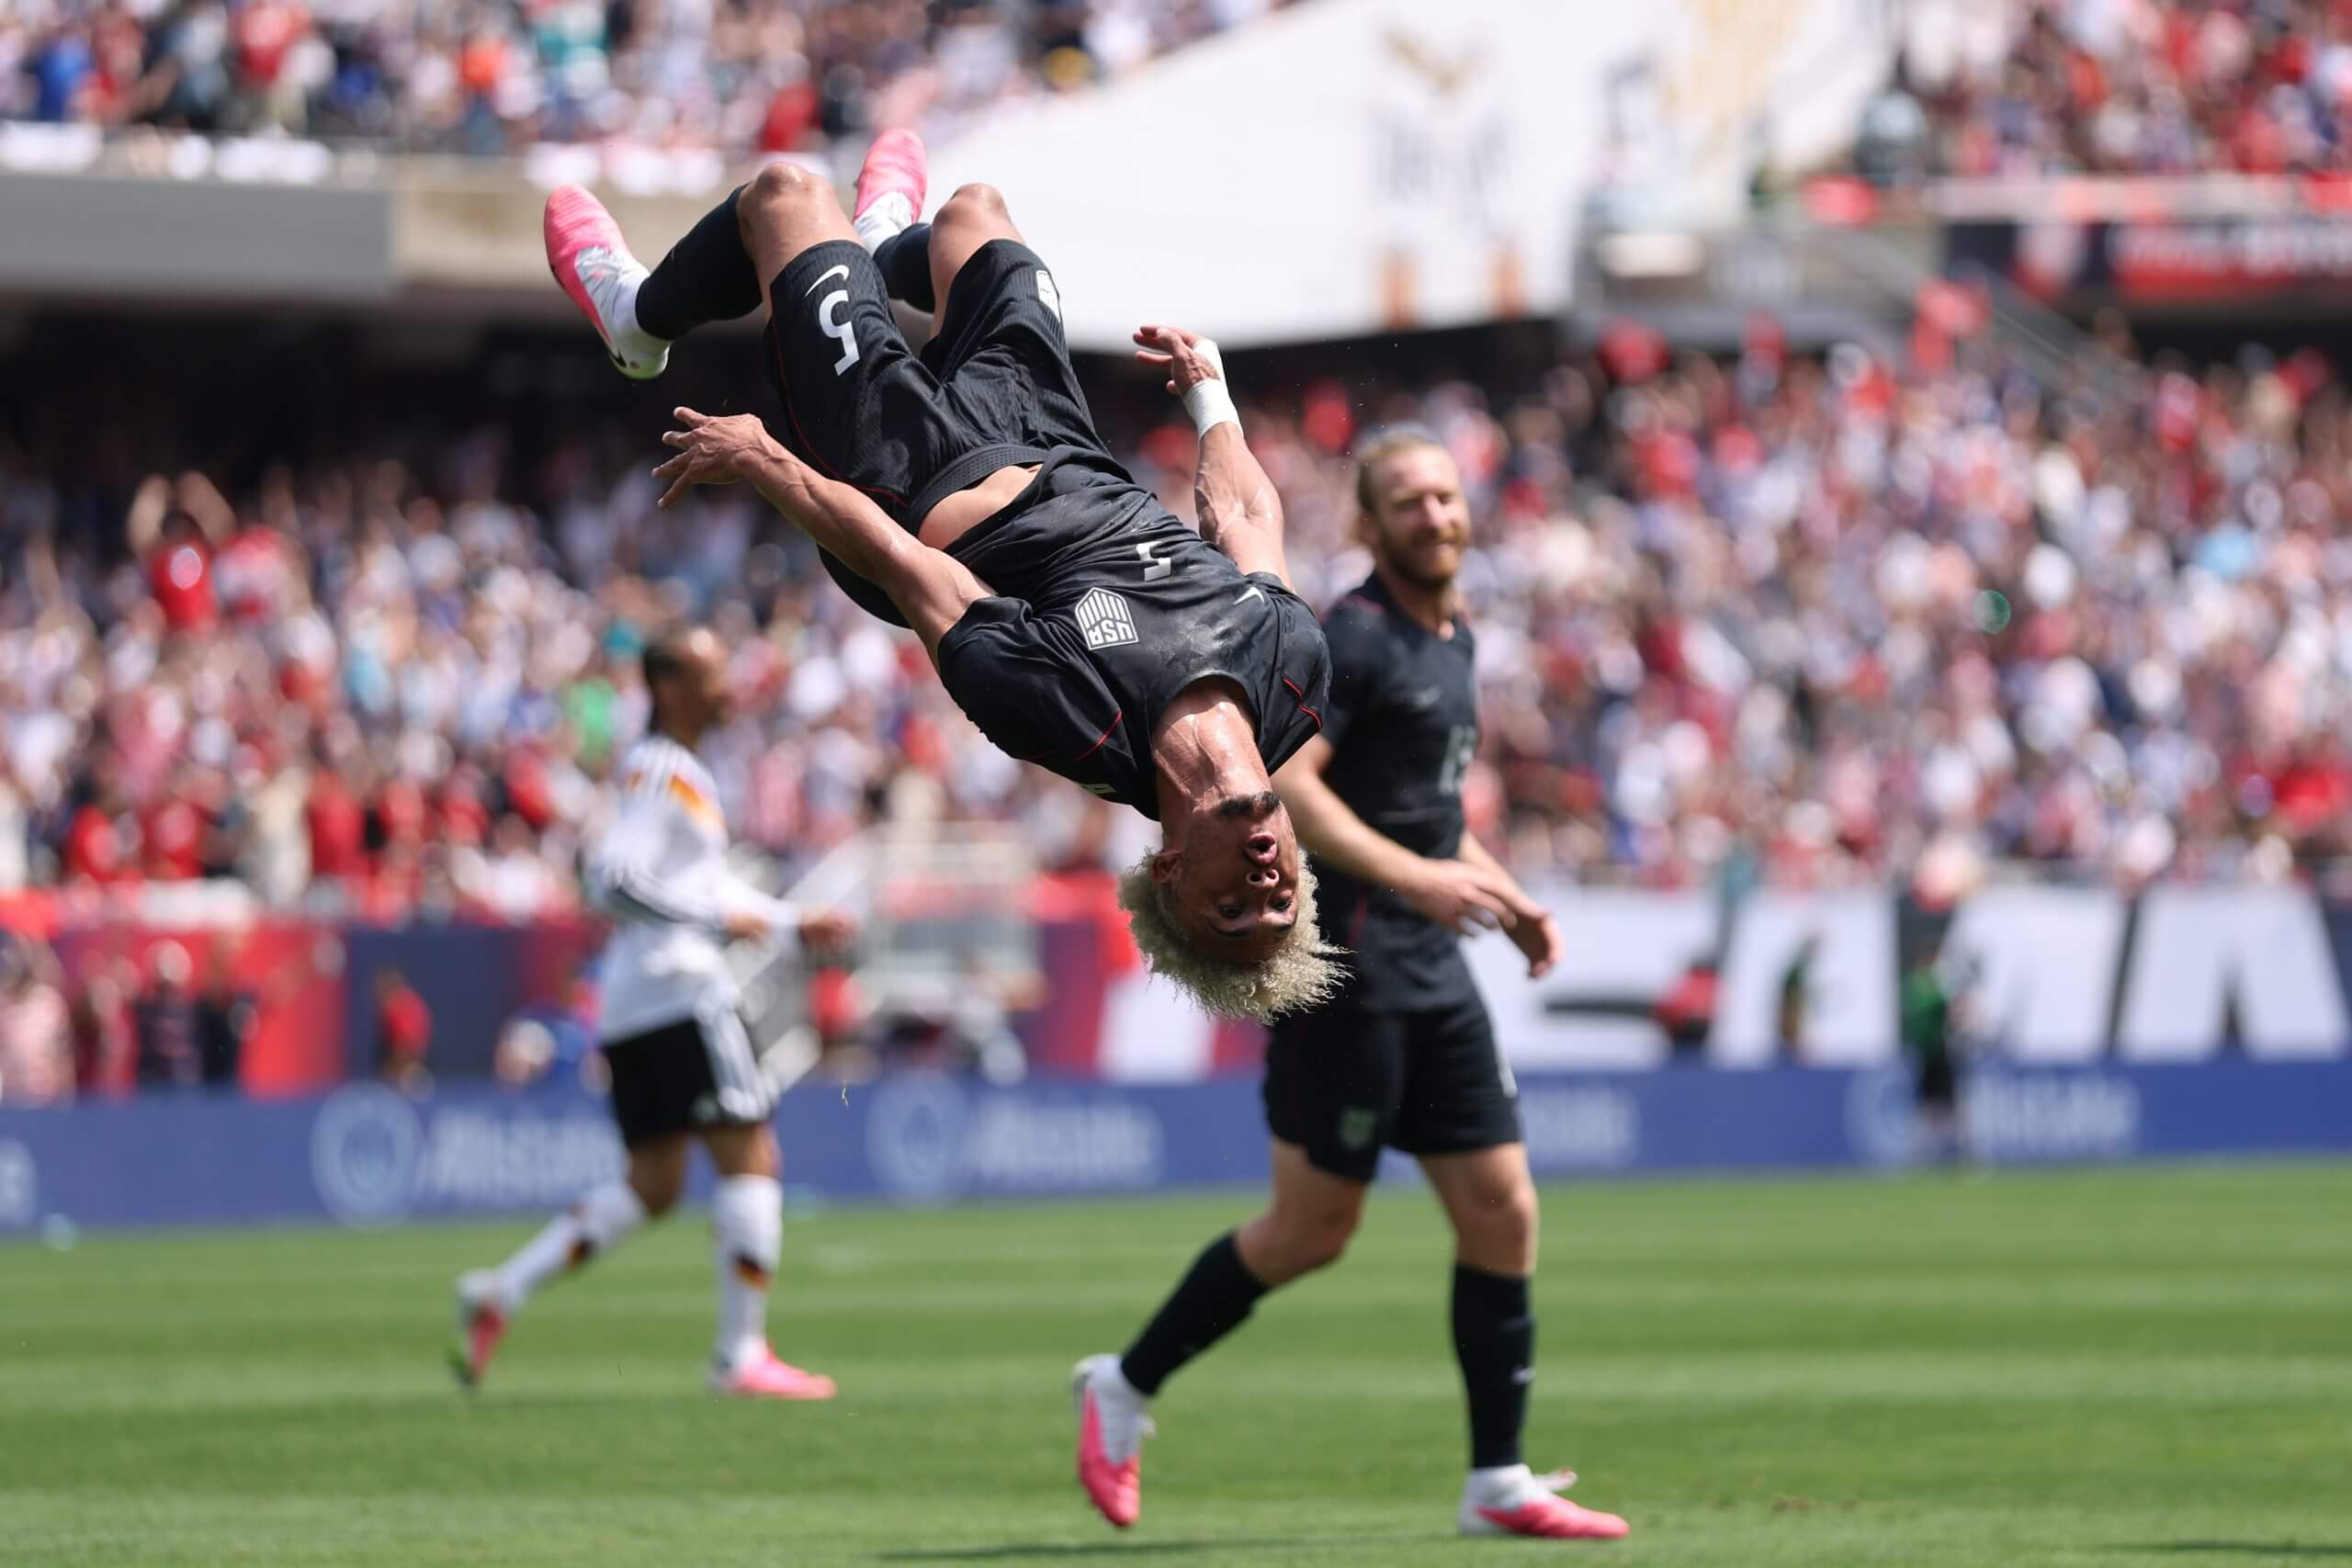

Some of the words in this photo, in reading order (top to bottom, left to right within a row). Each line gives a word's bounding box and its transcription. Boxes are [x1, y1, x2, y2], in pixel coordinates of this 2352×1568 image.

[819, 289, 860, 376] 5
[1136, 541, 1171, 581] 5
[1087, 620, 1134, 646] USA
